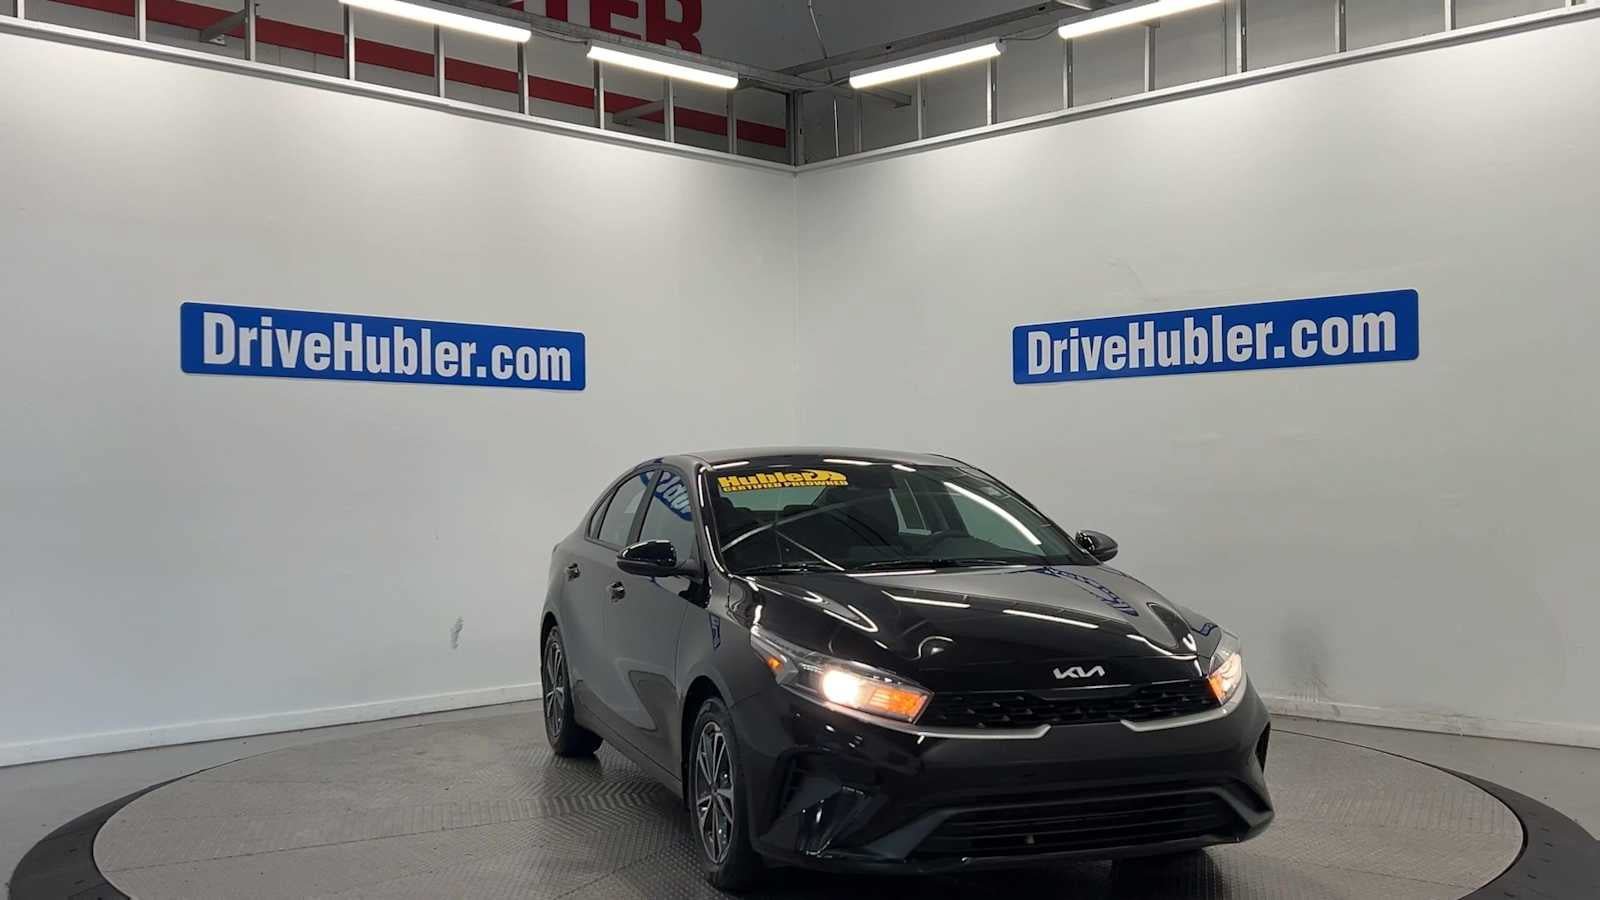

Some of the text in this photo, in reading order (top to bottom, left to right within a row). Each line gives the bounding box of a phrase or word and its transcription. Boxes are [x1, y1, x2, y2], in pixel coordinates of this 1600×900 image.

[203, 312, 571, 382] DriveHubler.com
[1027, 310, 1396, 375] DriveHubler.com
[718, 471, 819, 487] Hubler
[722, 481, 782, 492] CERTIFIED
[1053, 665, 1106, 679] KIA
